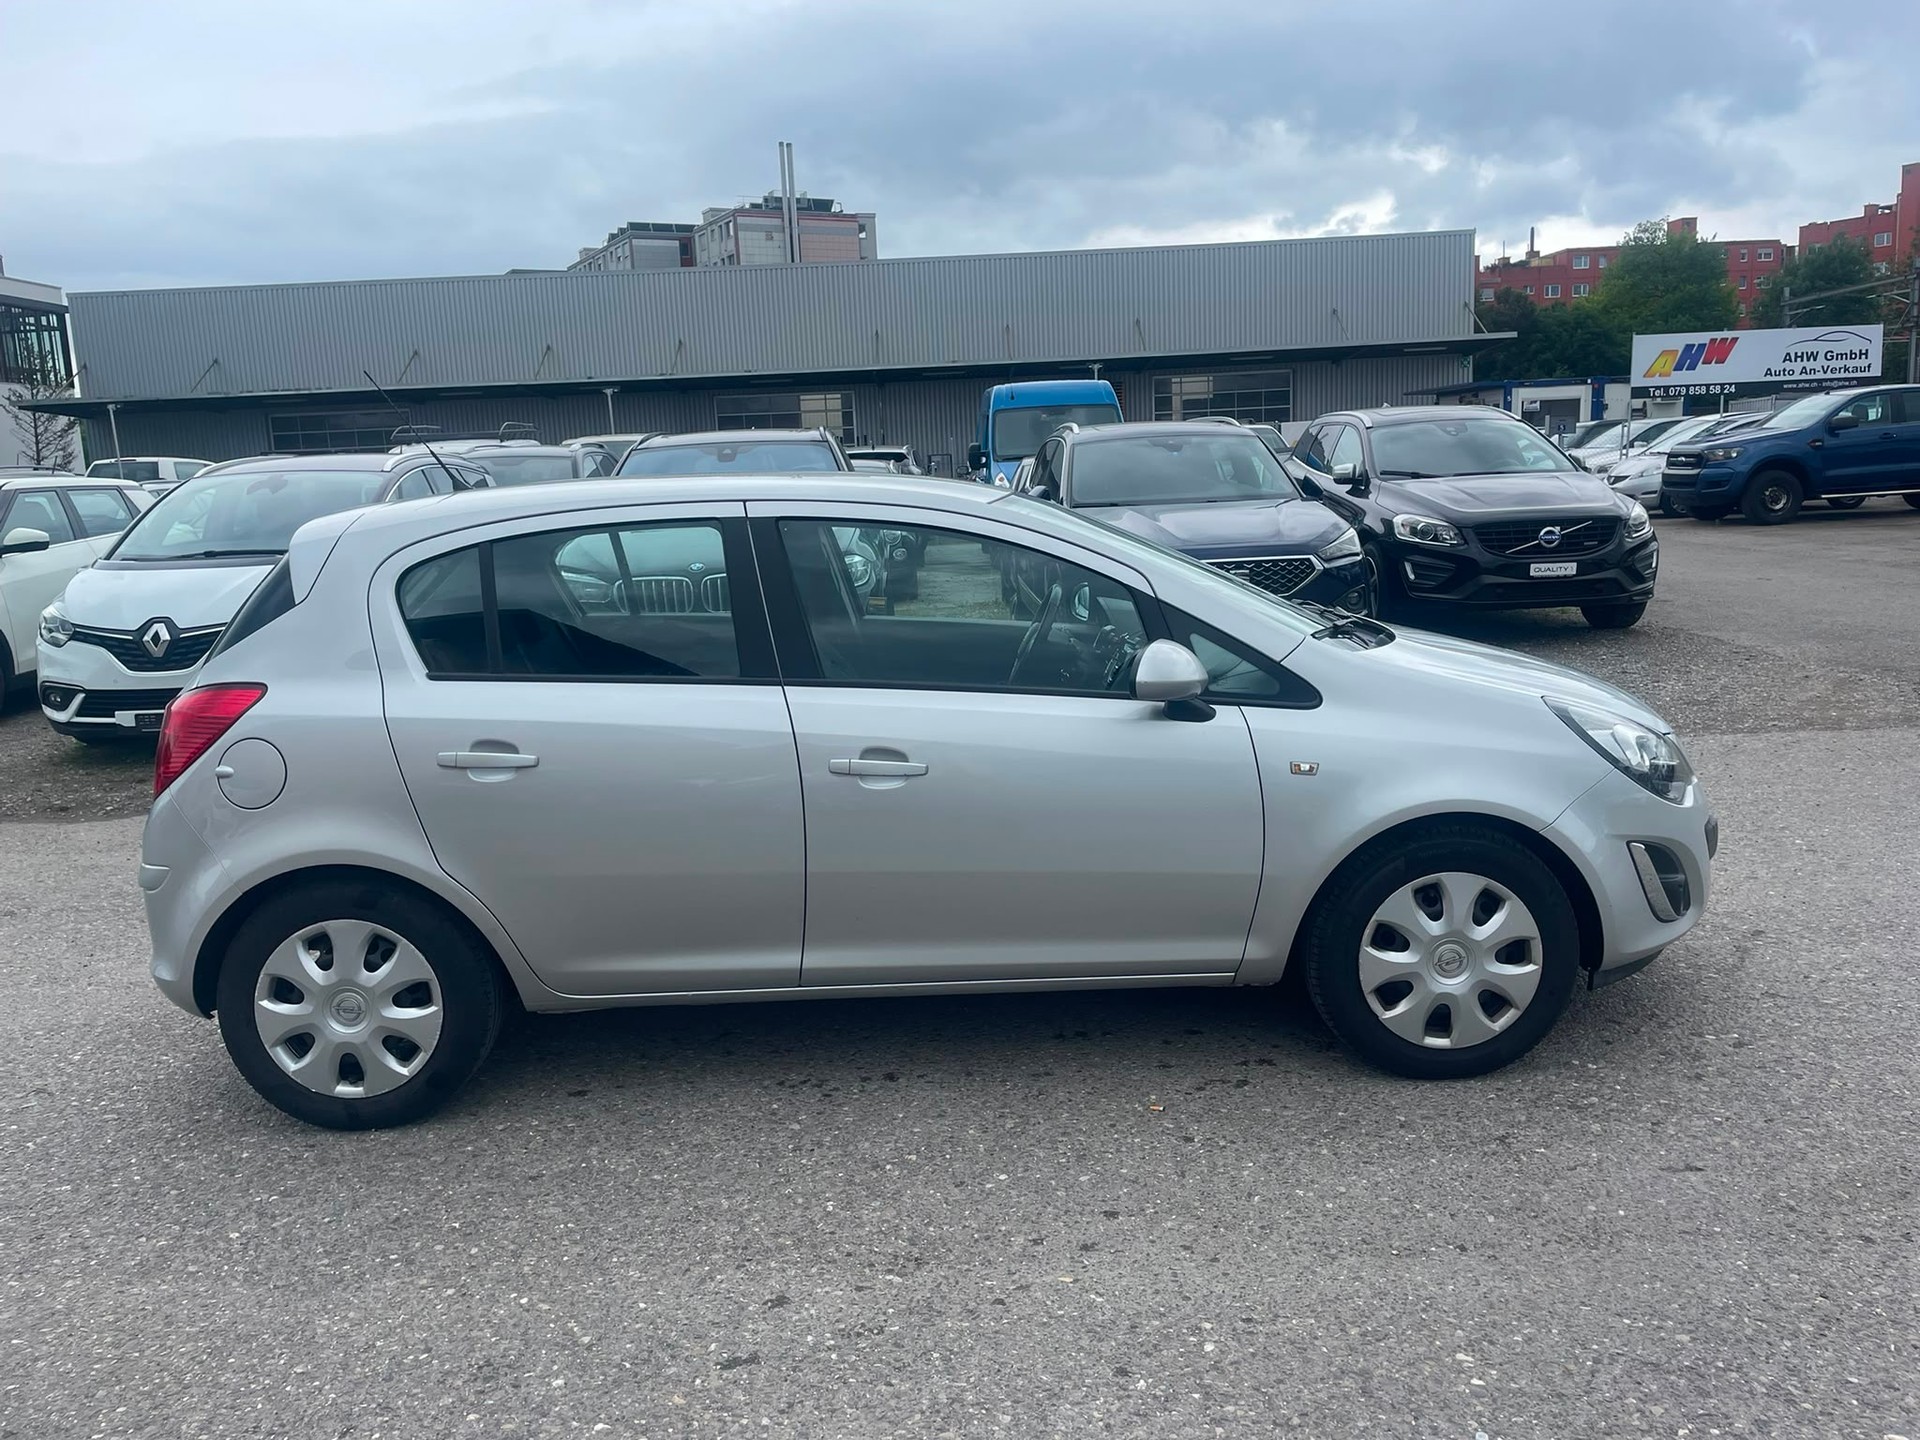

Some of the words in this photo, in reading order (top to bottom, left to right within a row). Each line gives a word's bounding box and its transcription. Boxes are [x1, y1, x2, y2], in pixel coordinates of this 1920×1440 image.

[1643, 337, 1740, 378] AHW
[1782, 351, 1819, 363] AHW
[1824, 349, 1869, 361] GmbH
[1764, 368, 1795, 377] Auto
[1799, 363, 1872, 375] An-Verkauf
[1649, 387, 1666, 396] Tel.
[1669, 386, 1687, 396] 079
[1688, 385, 1706, 395] 858
[1709, 385, 1721, 394] 58
[1723, 383, 1736, 394] 24
